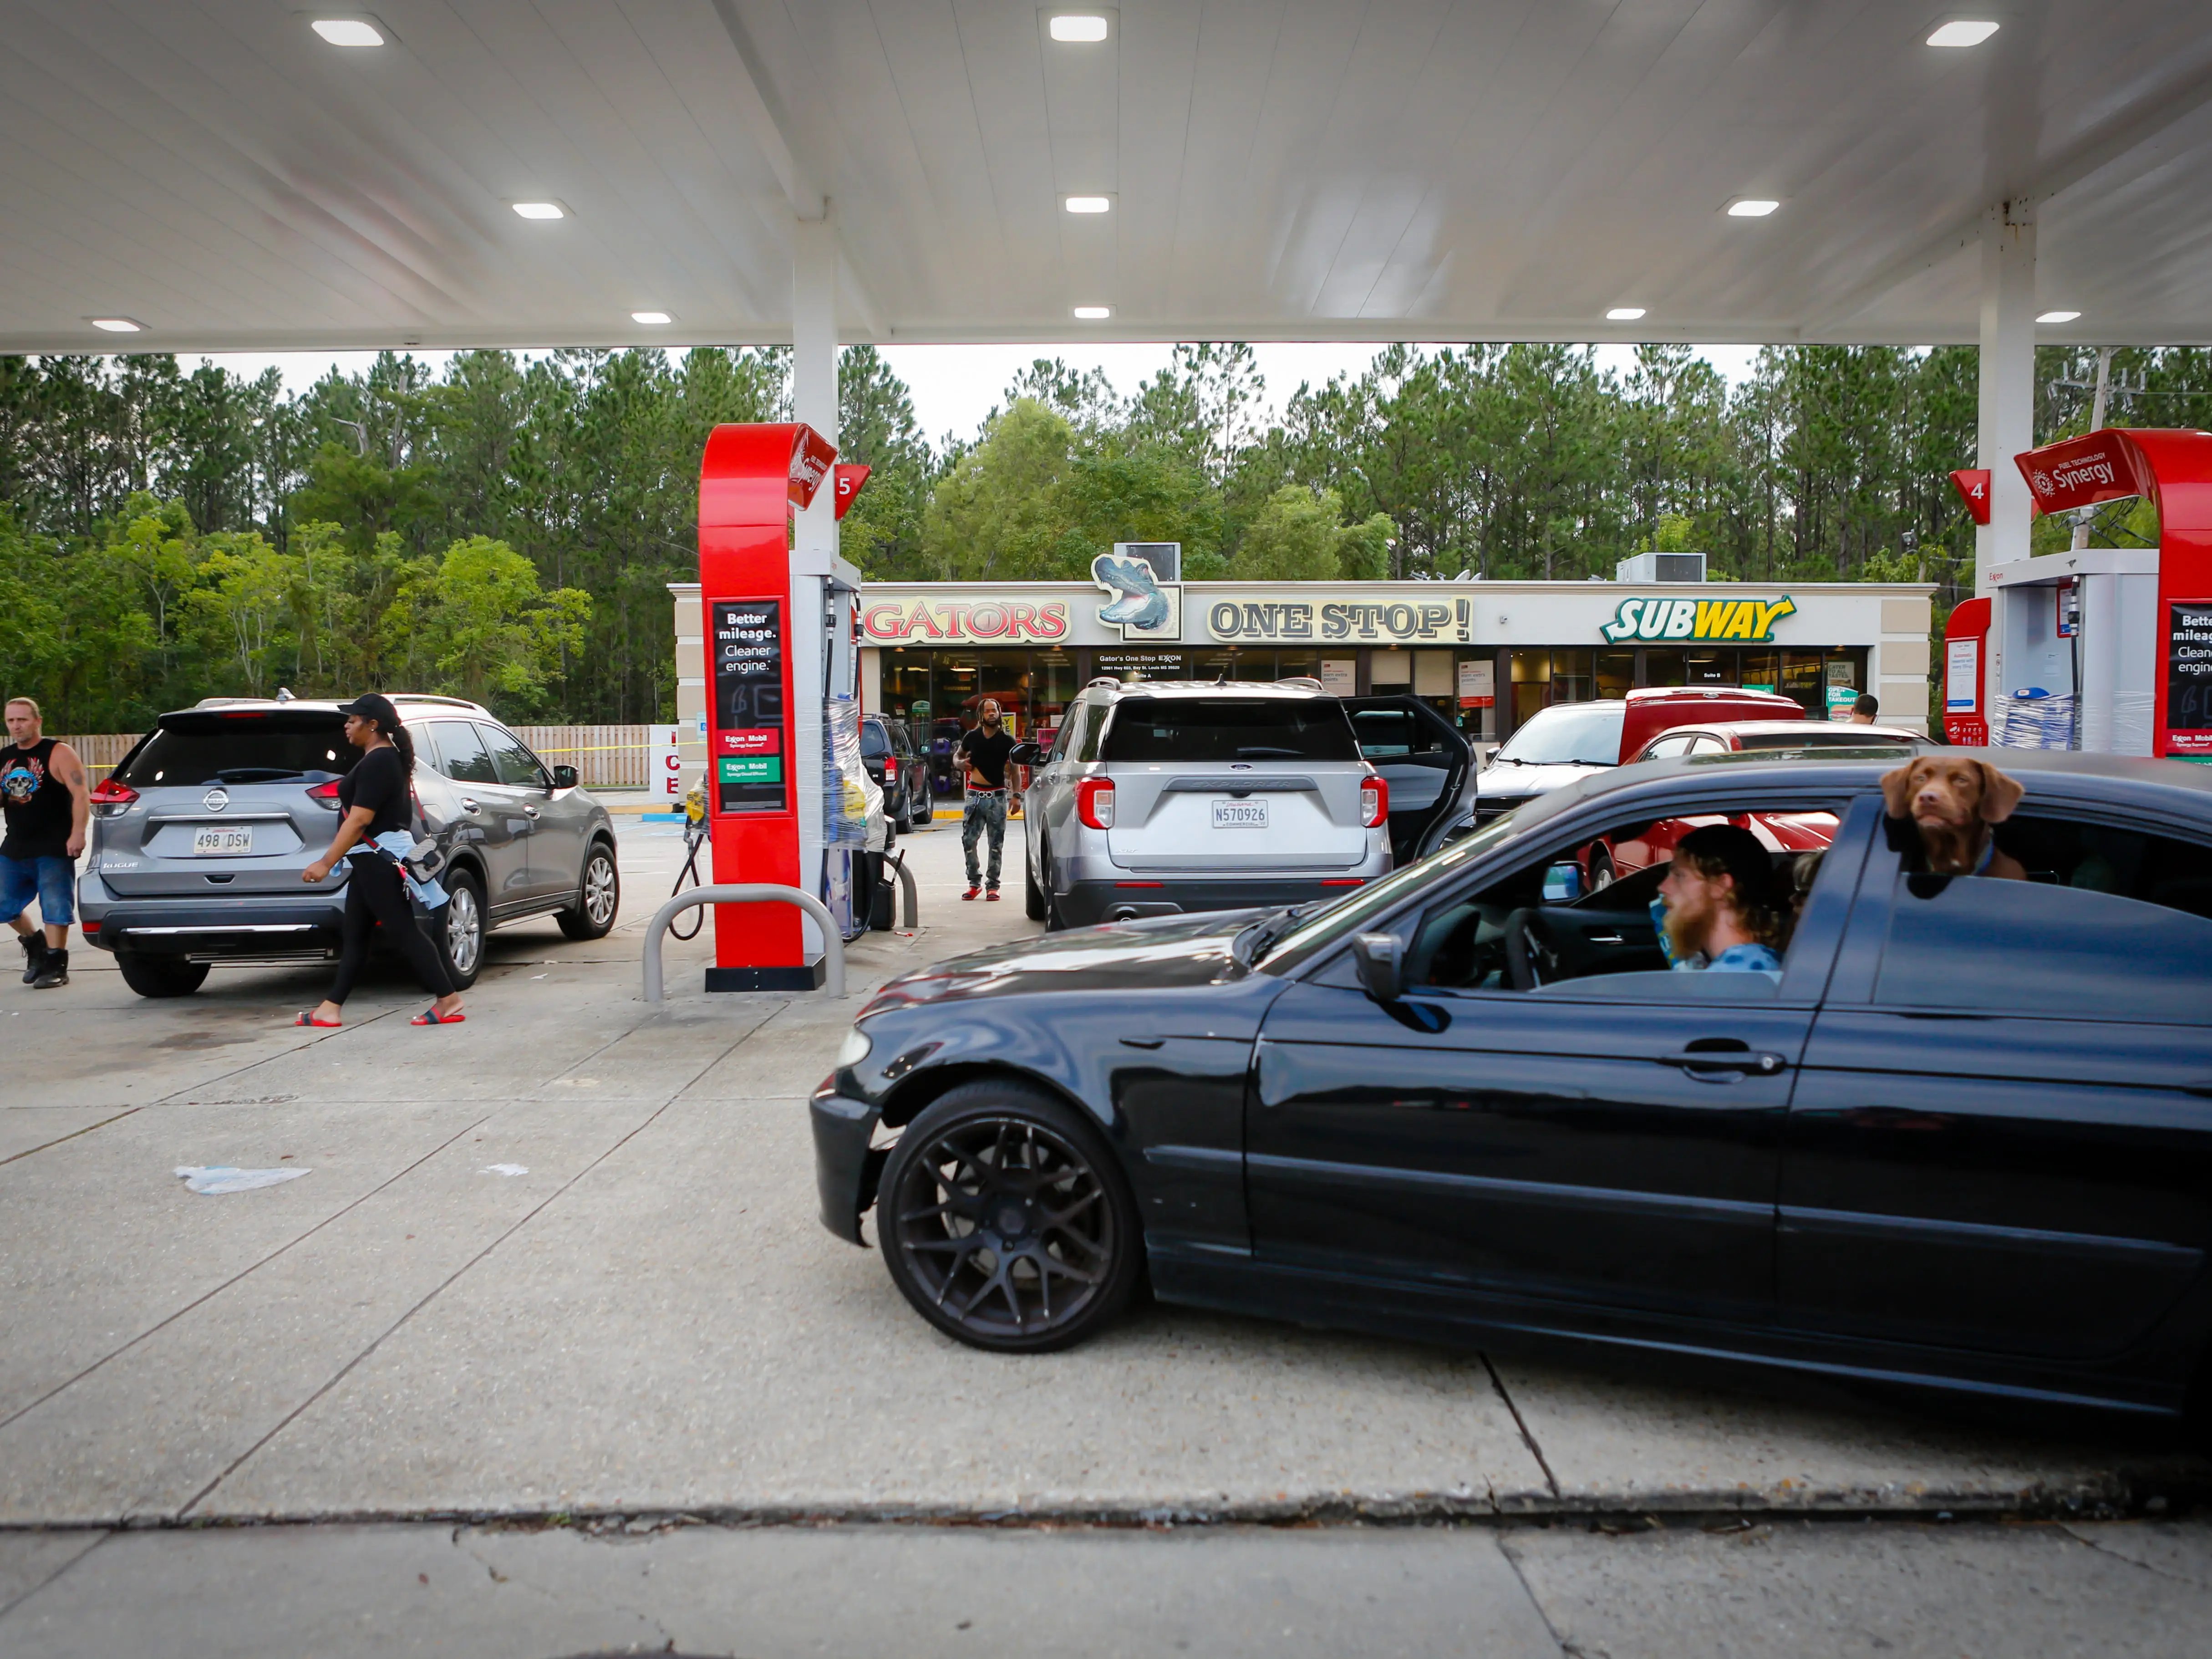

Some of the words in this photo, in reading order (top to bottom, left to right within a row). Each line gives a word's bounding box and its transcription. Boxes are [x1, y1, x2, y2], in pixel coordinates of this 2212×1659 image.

[2059, 462, 2071, 470] FUEL
[2071, 453, 2105, 467] TECHNOLOGY
[2053, 462, 2115, 491] Synergy
[839, 478, 850, 495] 5
[1971, 483, 1984, 499] 4
[1989, 573, 2003, 582] Exxon
[727, 613, 768, 624] Better
[864, 601, 1066, 638] GATORS
[1210, 602, 1312, 638] ONE
[1321, 598, 1470, 641] STOP!
[1605, 598, 1795, 641] SUBWAY
[719, 627, 777, 641] mileage.
[725, 645, 772, 656] Cleaner
[2178, 646, 2212, 657] Clean
[1158, 654, 1182, 663] EXXON
[2178, 662, 2212, 675] engin
[2172, 735, 2192, 743] Exxon
[727, 763, 745, 772] Exxon
[1216, 808, 1265, 821] N570926
[198, 835, 219, 847] 498
[227, 834, 249, 847] DSW
